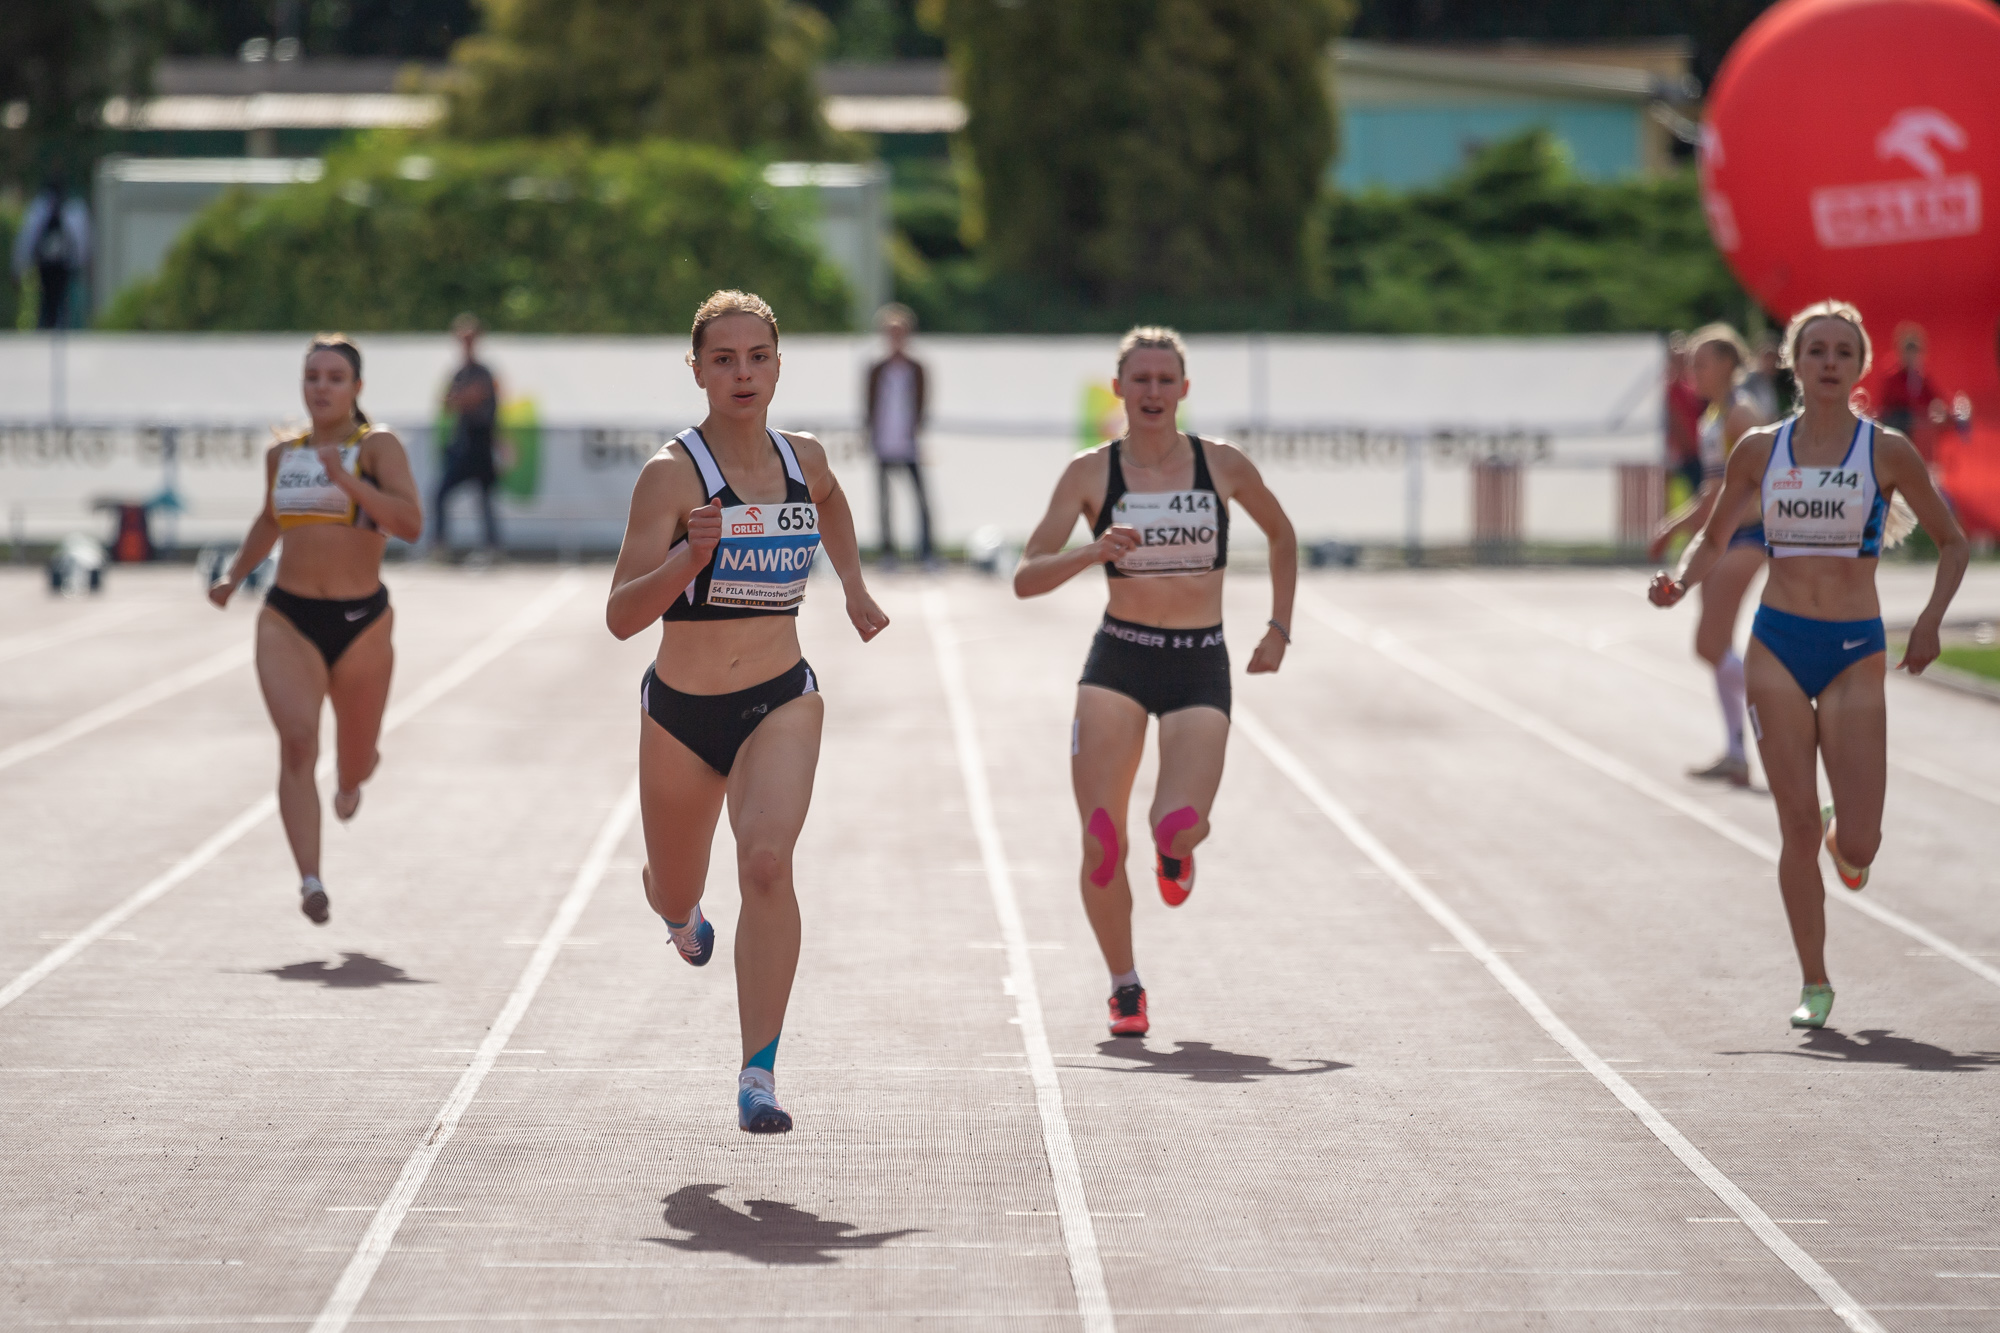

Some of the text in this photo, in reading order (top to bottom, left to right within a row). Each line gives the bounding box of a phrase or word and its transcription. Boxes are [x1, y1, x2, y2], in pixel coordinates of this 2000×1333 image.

[1819, 471, 1858, 489] 744
[1168, 495, 1210, 513] 414
[1777, 500, 1845, 519] NOBIK
[778, 507, 815, 531] 653
[733, 524, 763, 534] ORLEN
[1137, 527, 1214, 547] ESZNO
[720, 545, 816, 572] NAWROT
[712, 586, 723, 594] 54.
[726, 587, 743, 595] PZLA
[746, 589, 788, 598] Mistrzostwa
[1102, 624, 1165, 648] UNDER
